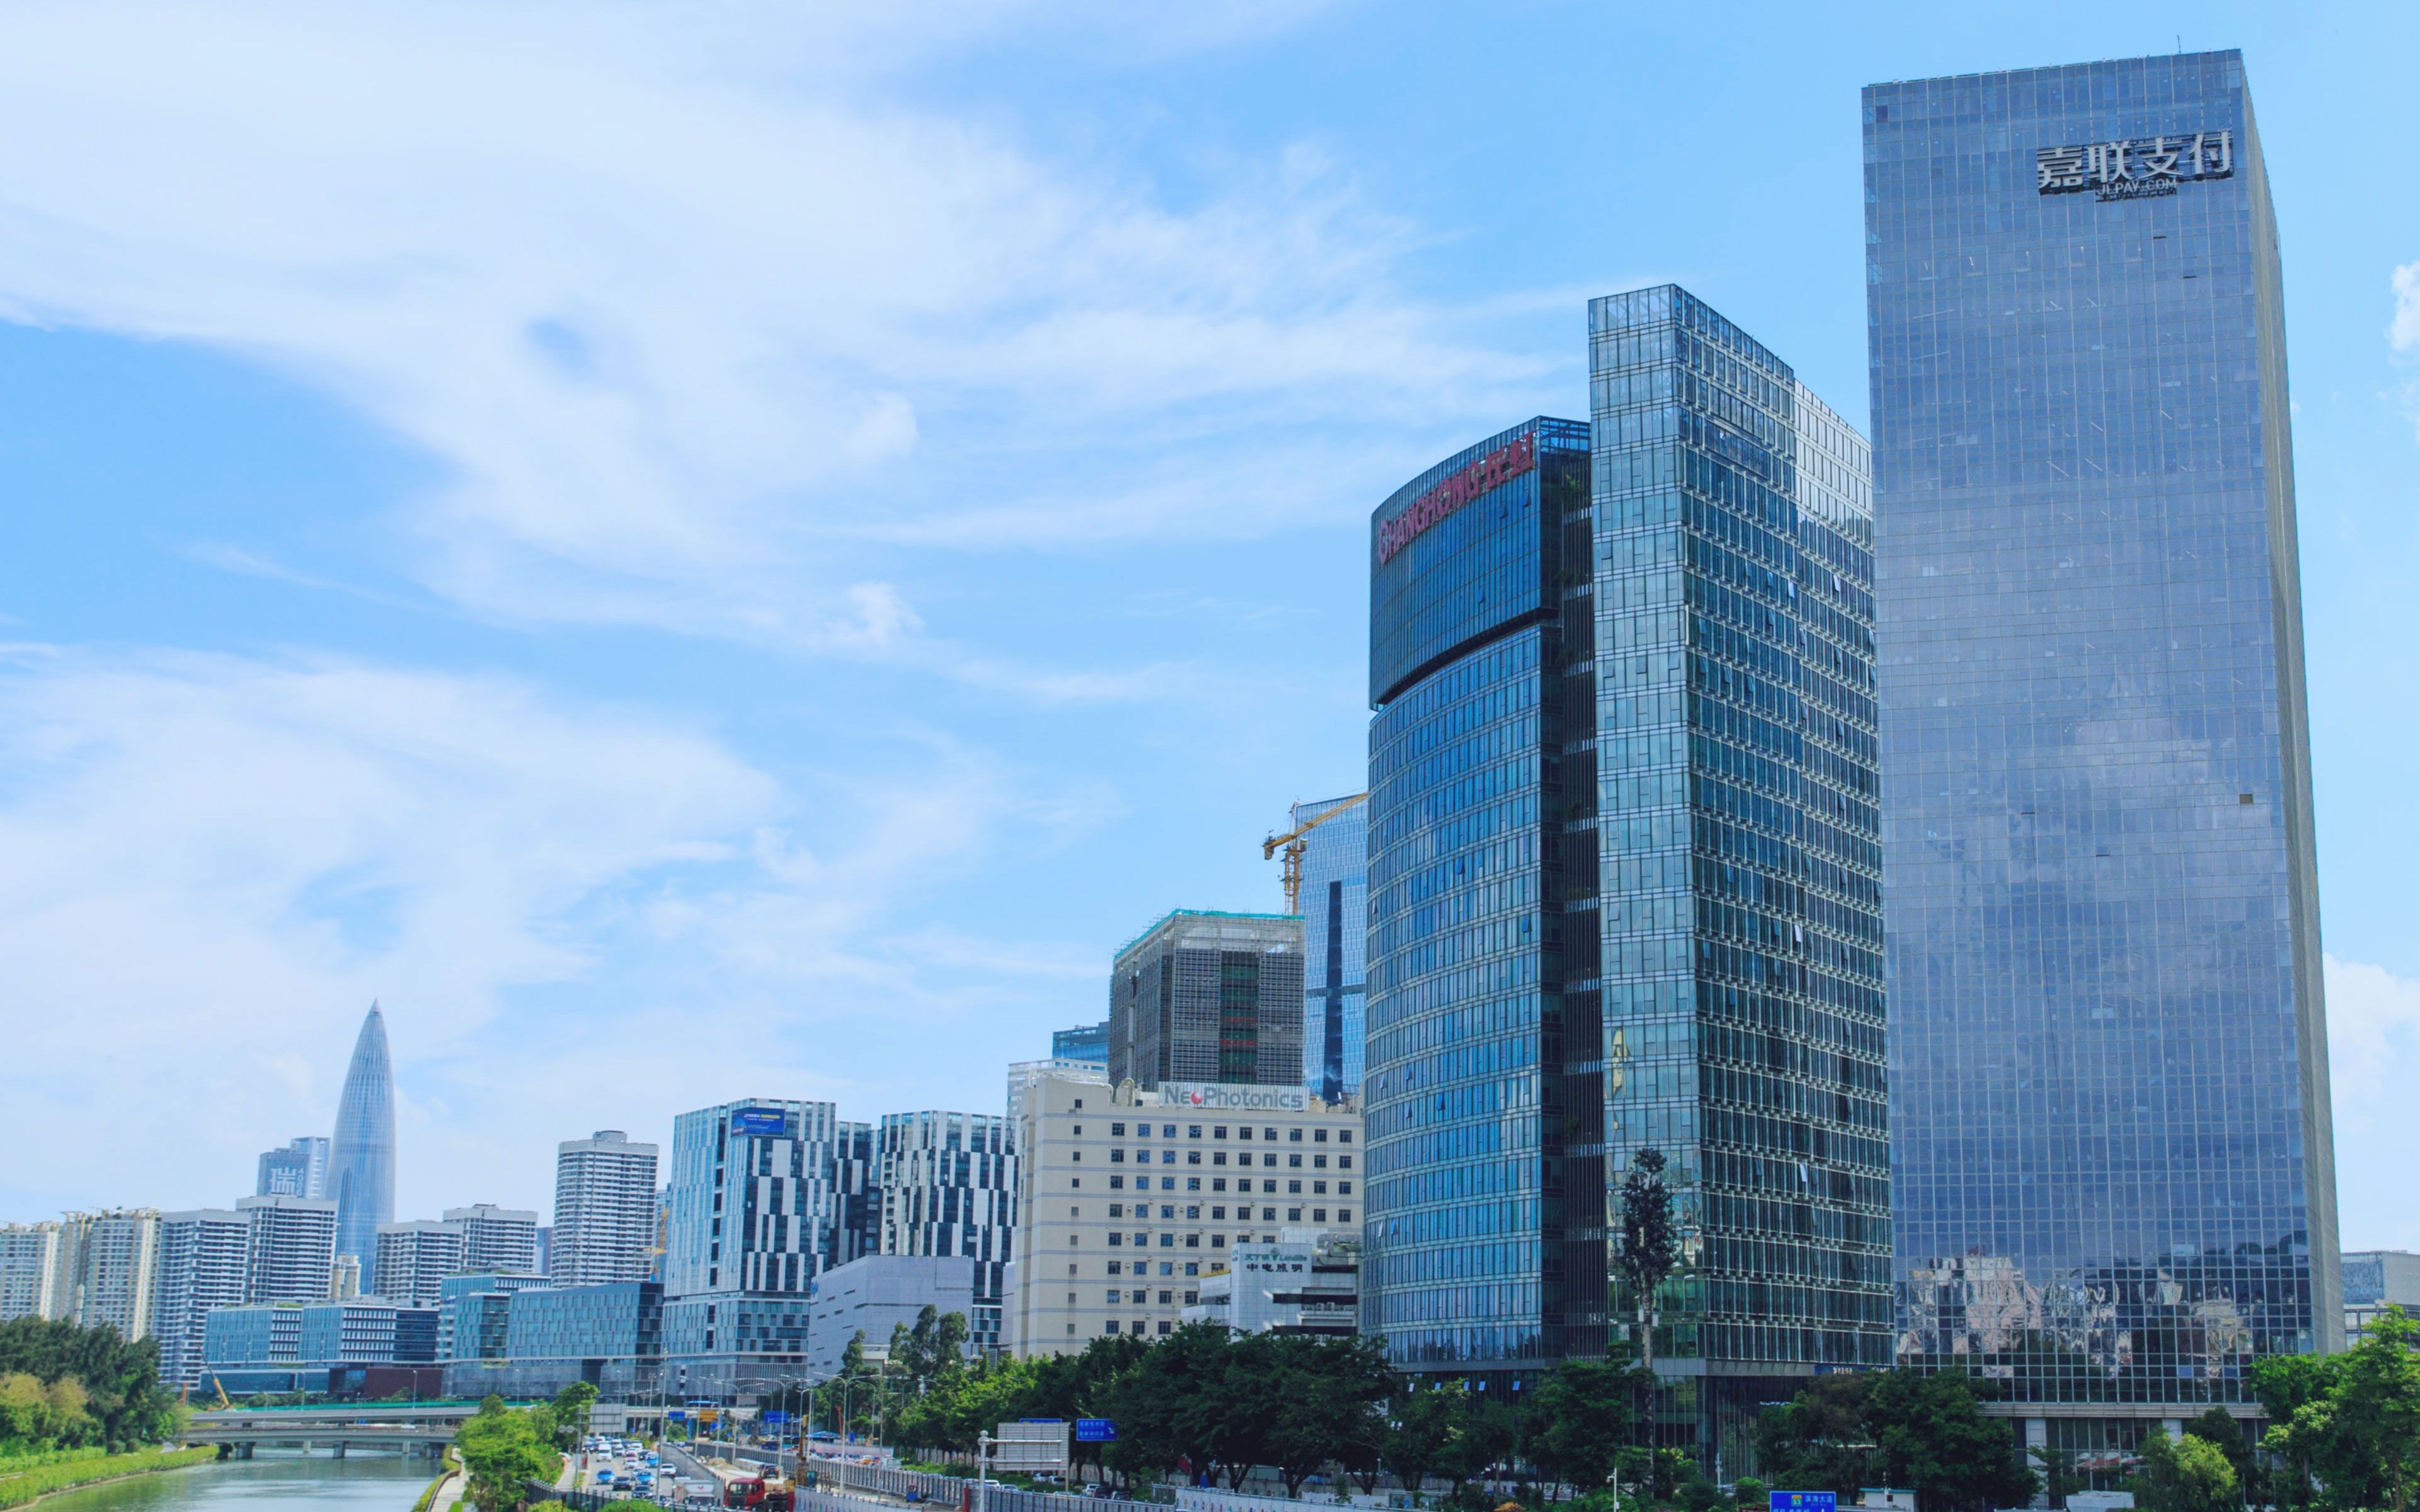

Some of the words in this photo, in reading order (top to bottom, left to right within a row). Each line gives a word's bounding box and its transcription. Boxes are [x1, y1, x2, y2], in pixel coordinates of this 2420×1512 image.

[2037, 130, 2234, 189] 嘉联支付
[1379, 461, 1479, 565] CHANGHONG
[1246, 1263, 1303, 1272] 中电照明
